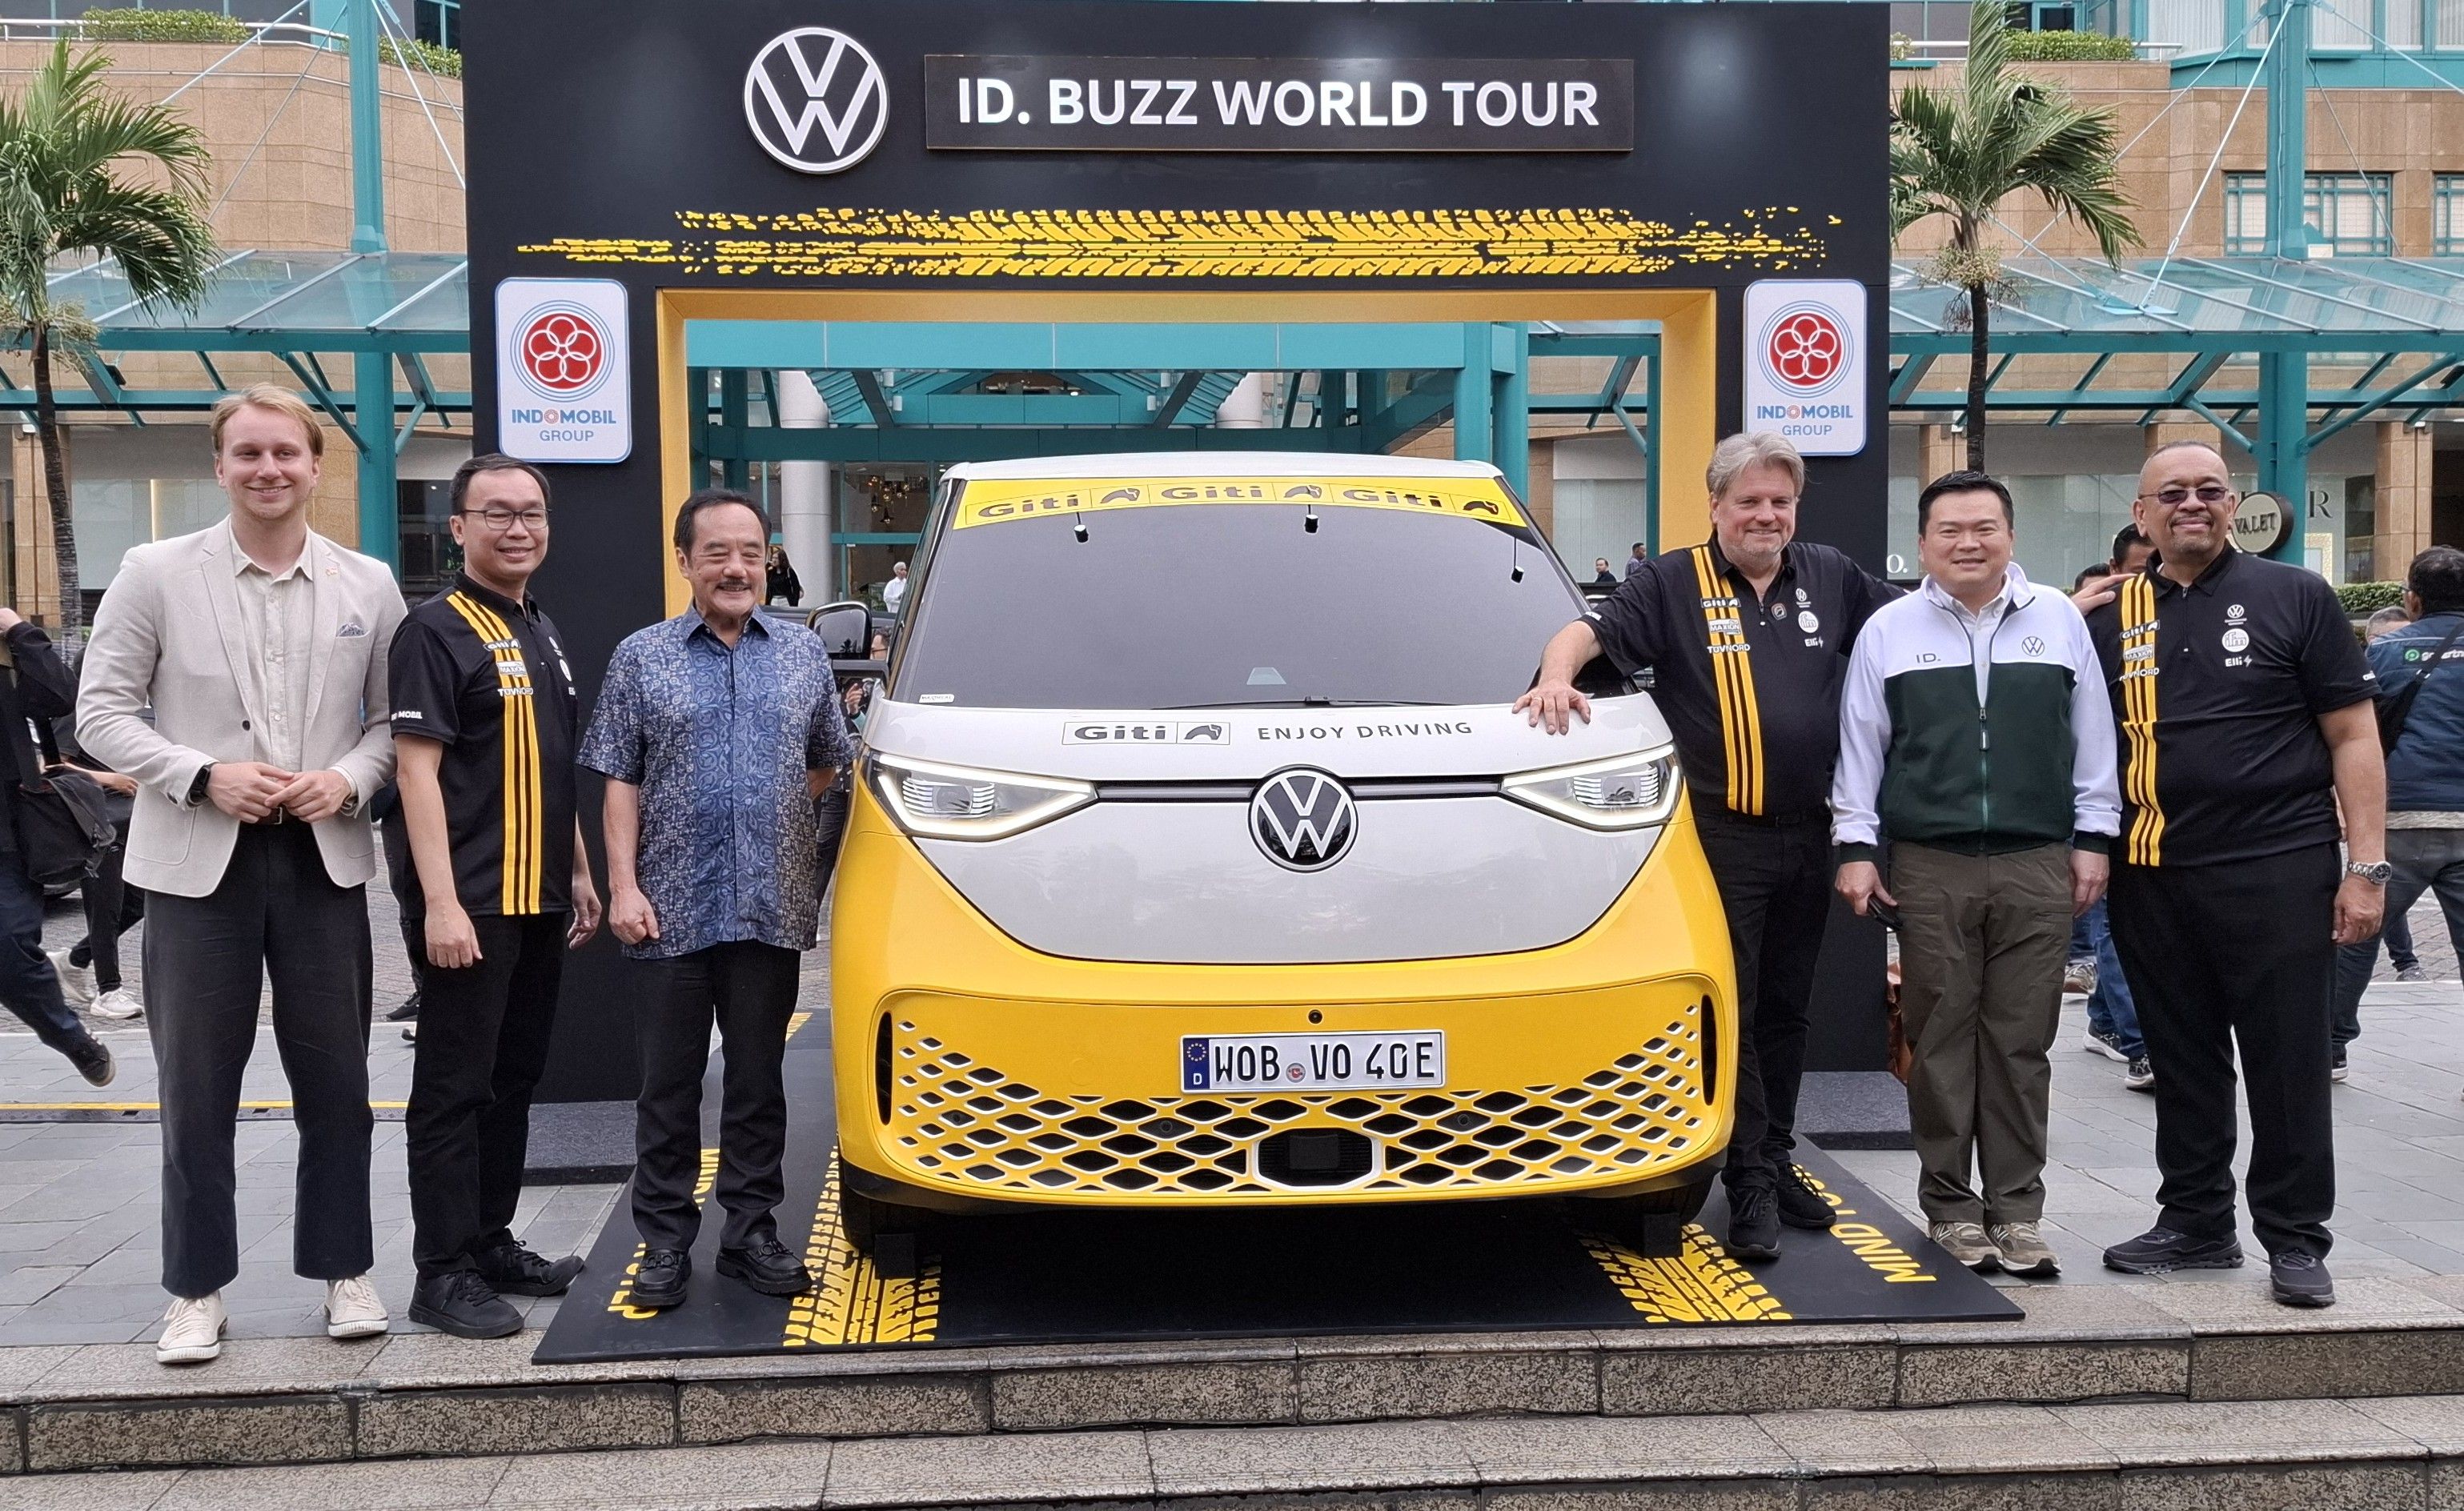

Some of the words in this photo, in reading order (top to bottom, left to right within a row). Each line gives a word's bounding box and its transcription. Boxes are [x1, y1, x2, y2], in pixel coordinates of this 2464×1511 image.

[959, 78, 1030, 125] ID.
[1049, 79, 1198, 125] BUZZ
[1212, 81, 1427, 126] WORLD
[1442, 82, 1599, 126] TOUR
[512, 409, 616, 424] INDOMOBIL
[1757, 404, 1853, 419] INDOMOBIL
[540, 430, 594, 442] GROUP
[1782, 425, 1832, 436] GROUP
[1161, 486, 1262, 499] Giti
[1342, 489, 1443, 507] Giti
[978, 494, 1078, 517] Giti
[2234, 512, 2277, 535] VALET
[1916, 653, 1941, 663] ID.
[1074, 725, 1166, 740] Giti
[1258, 727, 1344, 740] ENJOY
[1356, 722, 1473, 739] DRIVING
[1193, 1072, 1202, 1085] D
[1214, 1045, 1281, 1083] WOB
[1310, 1043, 1352, 1080] VO
[1366, 1041, 1435, 1080] 40E
[1829, 1224, 1937, 1282] MIND
